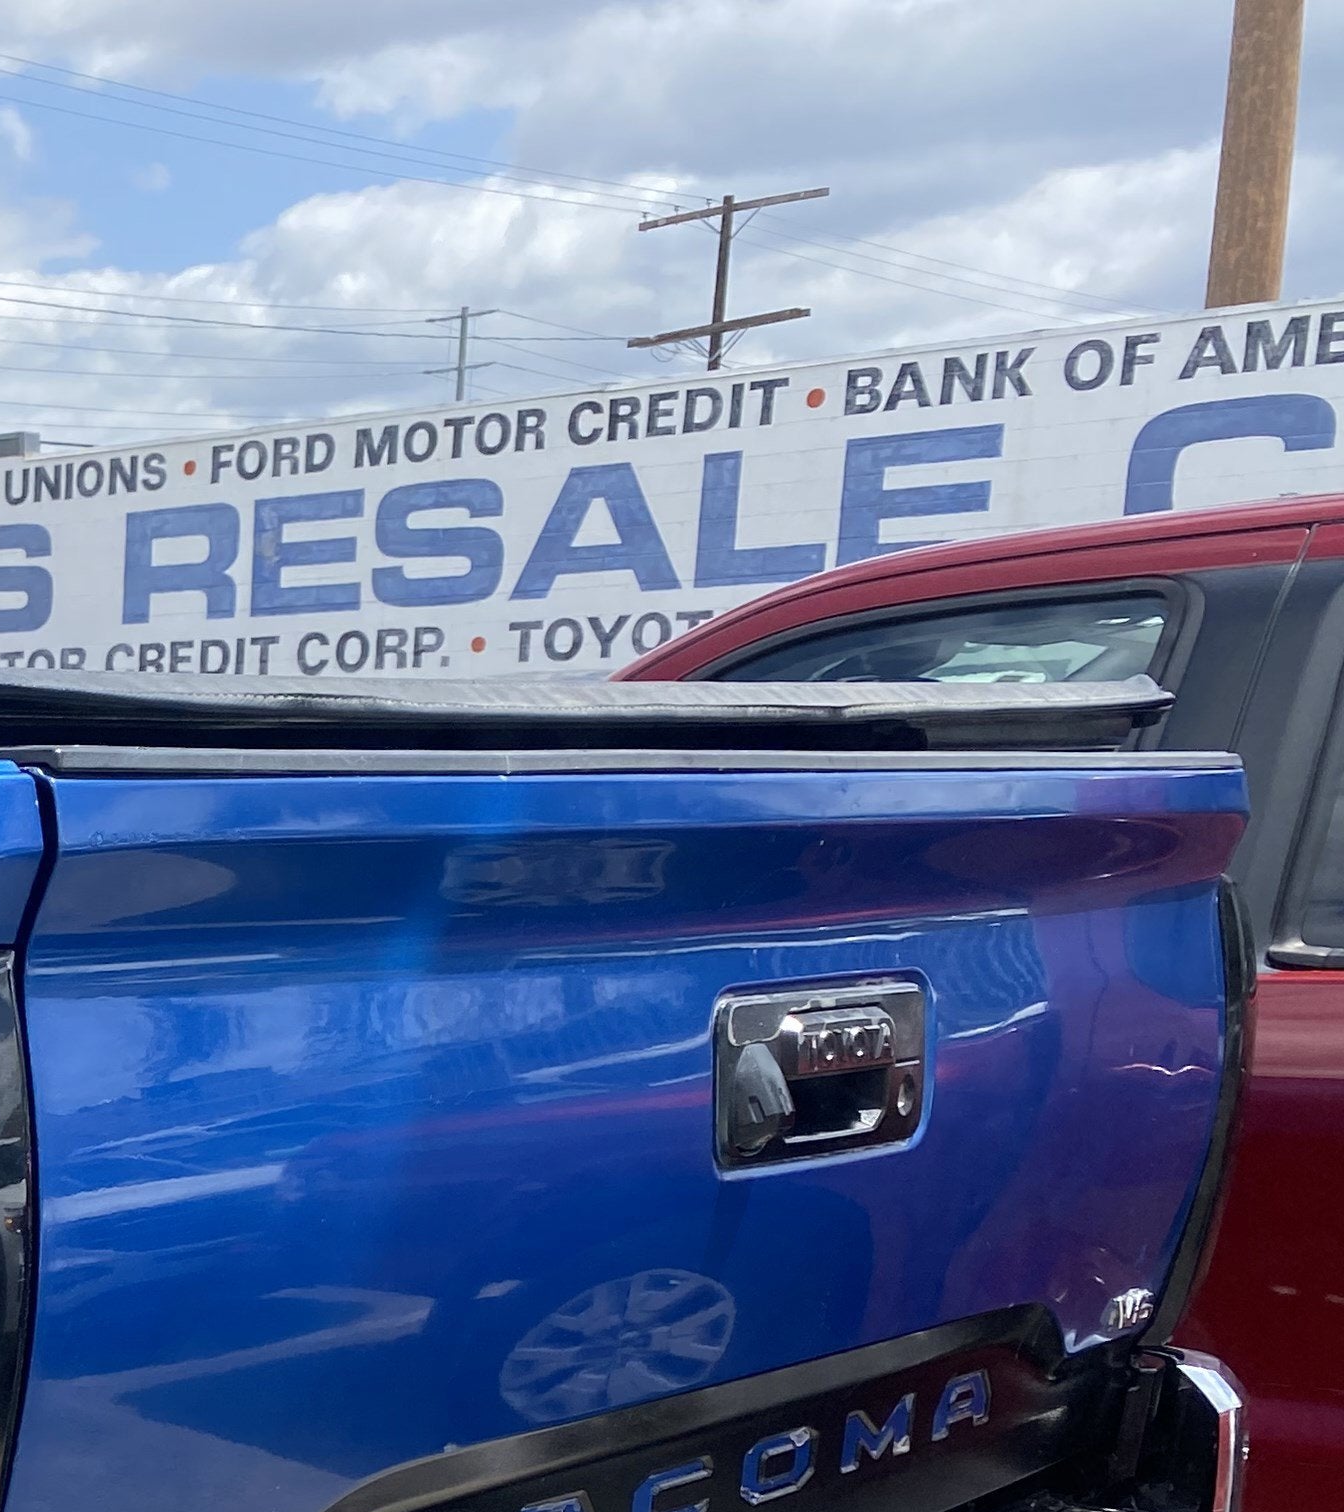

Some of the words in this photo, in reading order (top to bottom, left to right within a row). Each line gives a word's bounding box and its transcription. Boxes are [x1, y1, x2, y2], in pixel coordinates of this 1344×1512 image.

[5, 453, 168, 505] UNIONS
[210, 432, 336, 484] FORD
[353, 408, 547, 468] MOTOR
[568, 377, 789, 446] CREDIT
[844, 347, 1037, 416] BANK
[1064, 332, 1161, 391] OF
[1178, 311, 1344, 380] AME
[121, 424, 1004, 625] RESALE
[106, 635, 280, 675] CREDIT
[297, 627, 450, 676] CORP.
